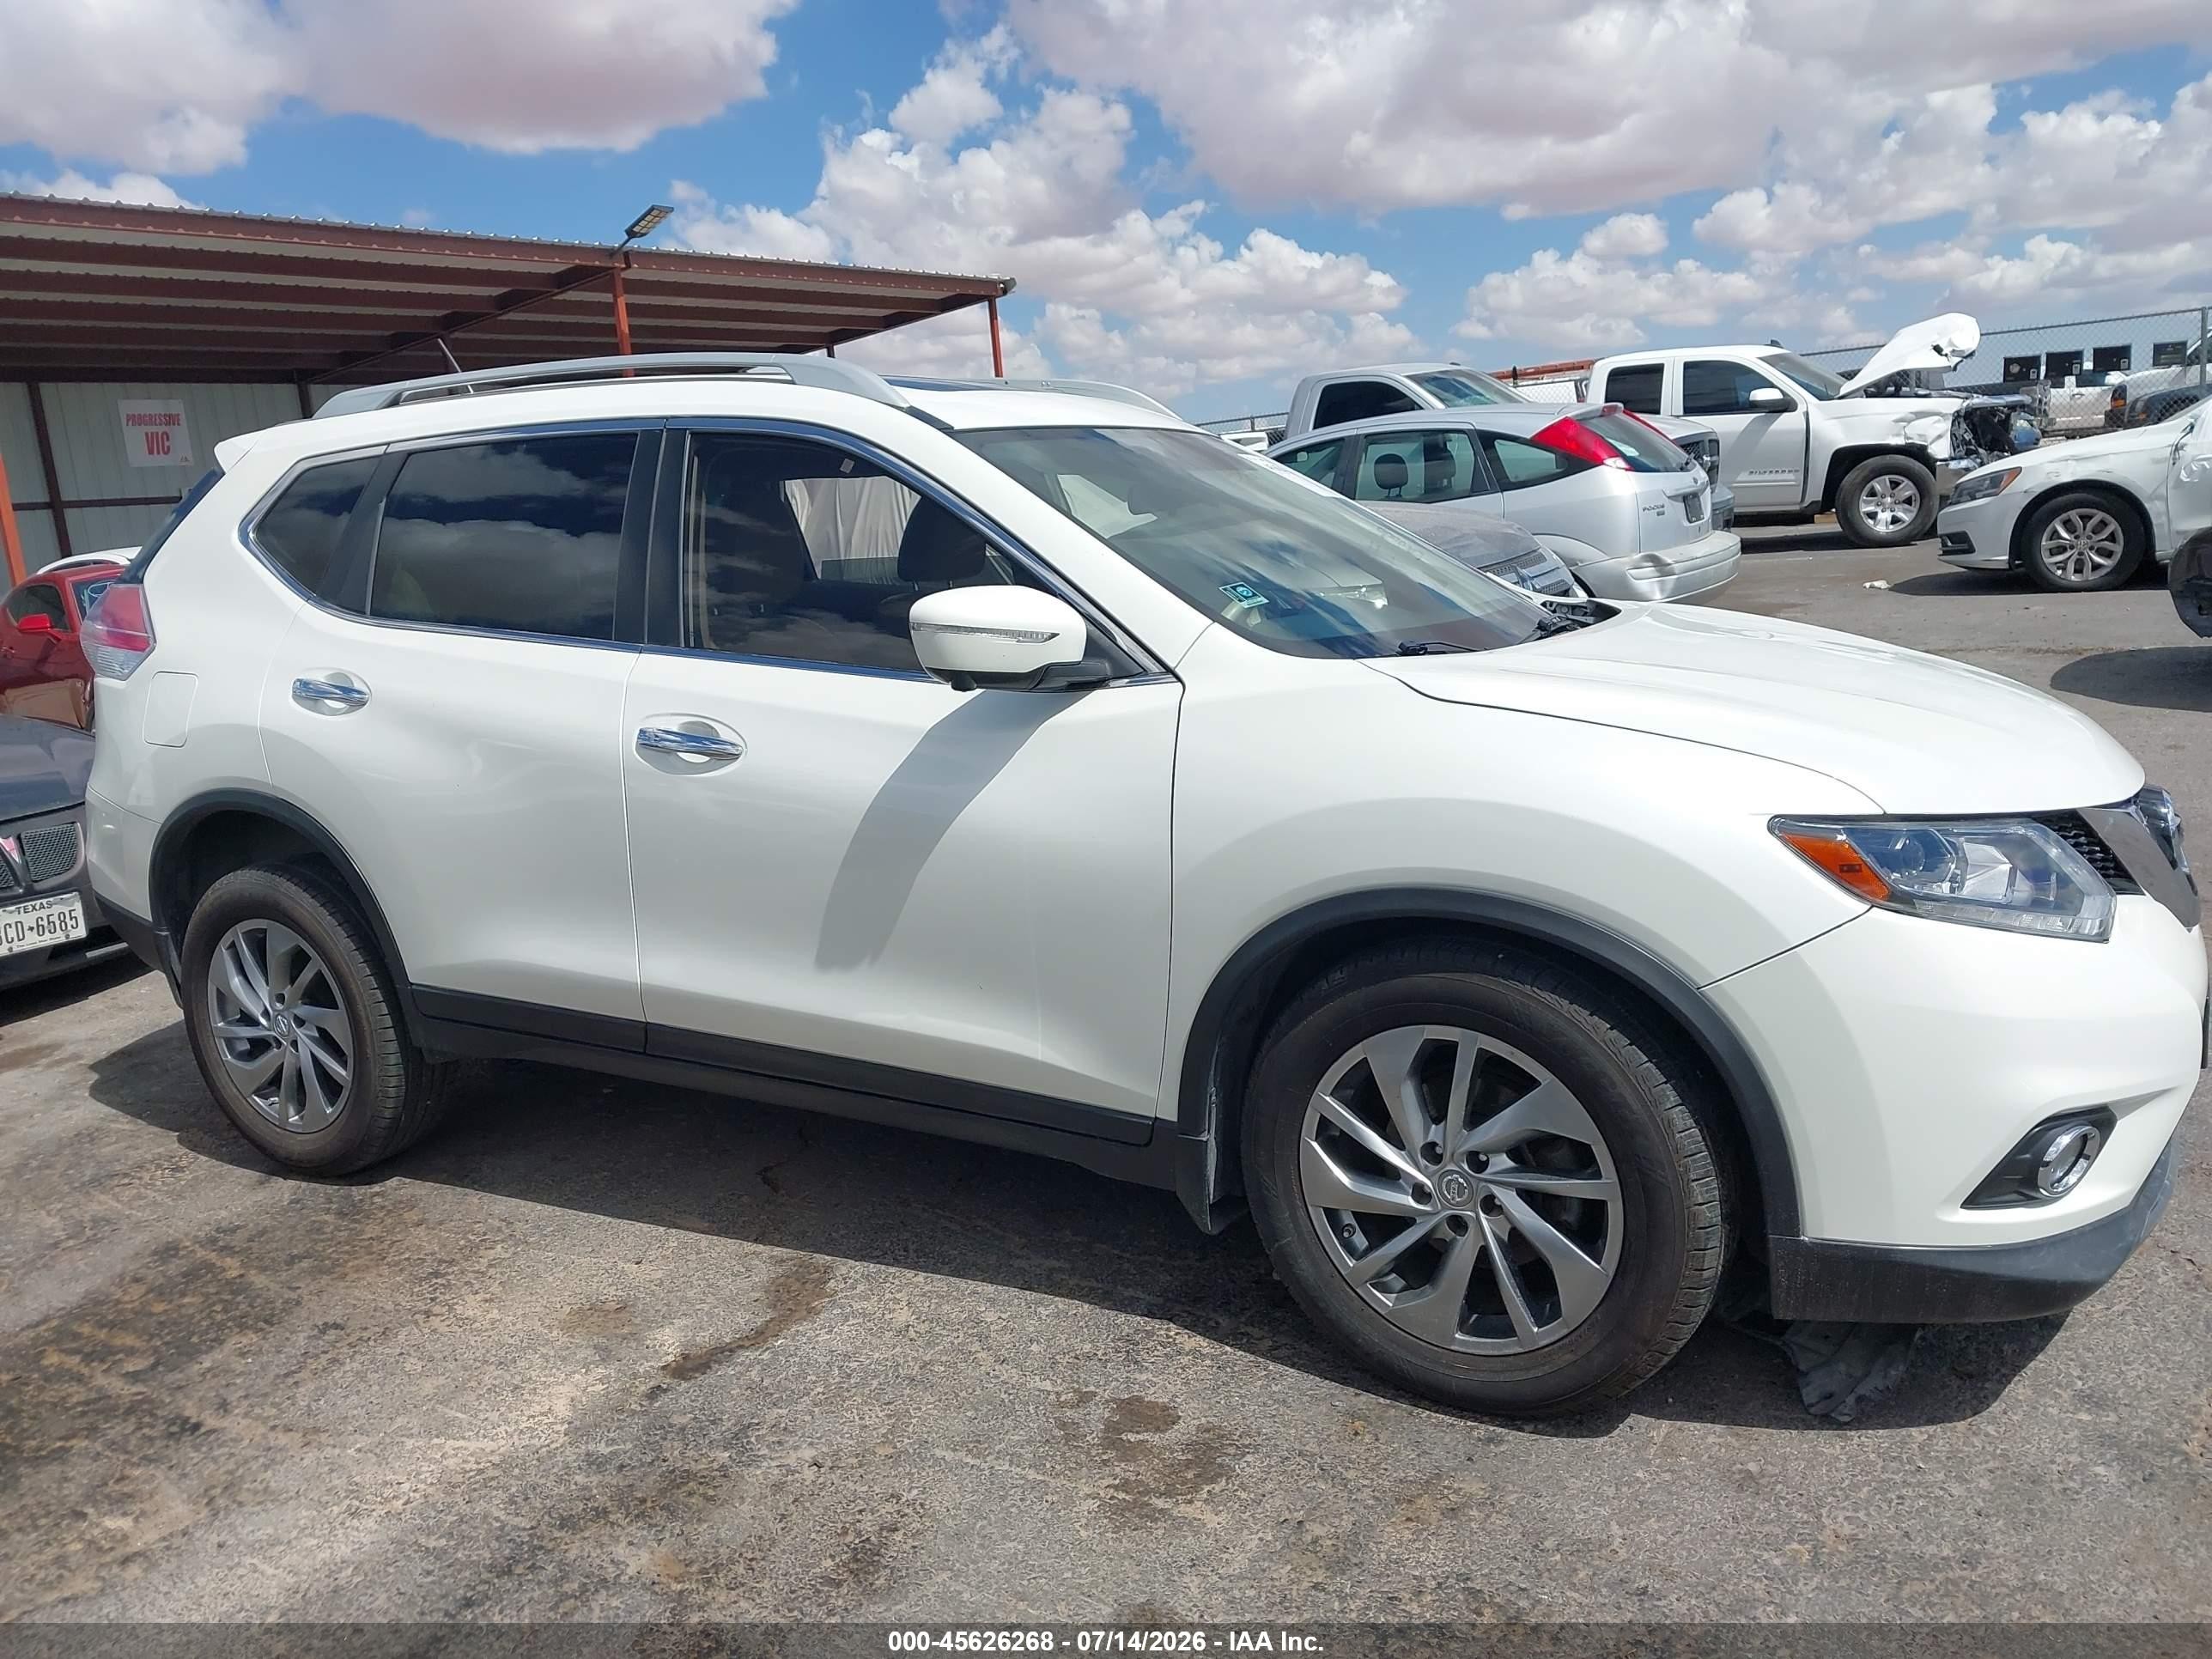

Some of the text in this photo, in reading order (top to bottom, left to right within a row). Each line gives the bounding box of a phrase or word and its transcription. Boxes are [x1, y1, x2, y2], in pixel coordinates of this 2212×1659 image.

[125, 412, 182, 427] PROGRESSIVE
[144, 431, 171, 456] VIC
[15, 900, 53, 915] TEXAS
